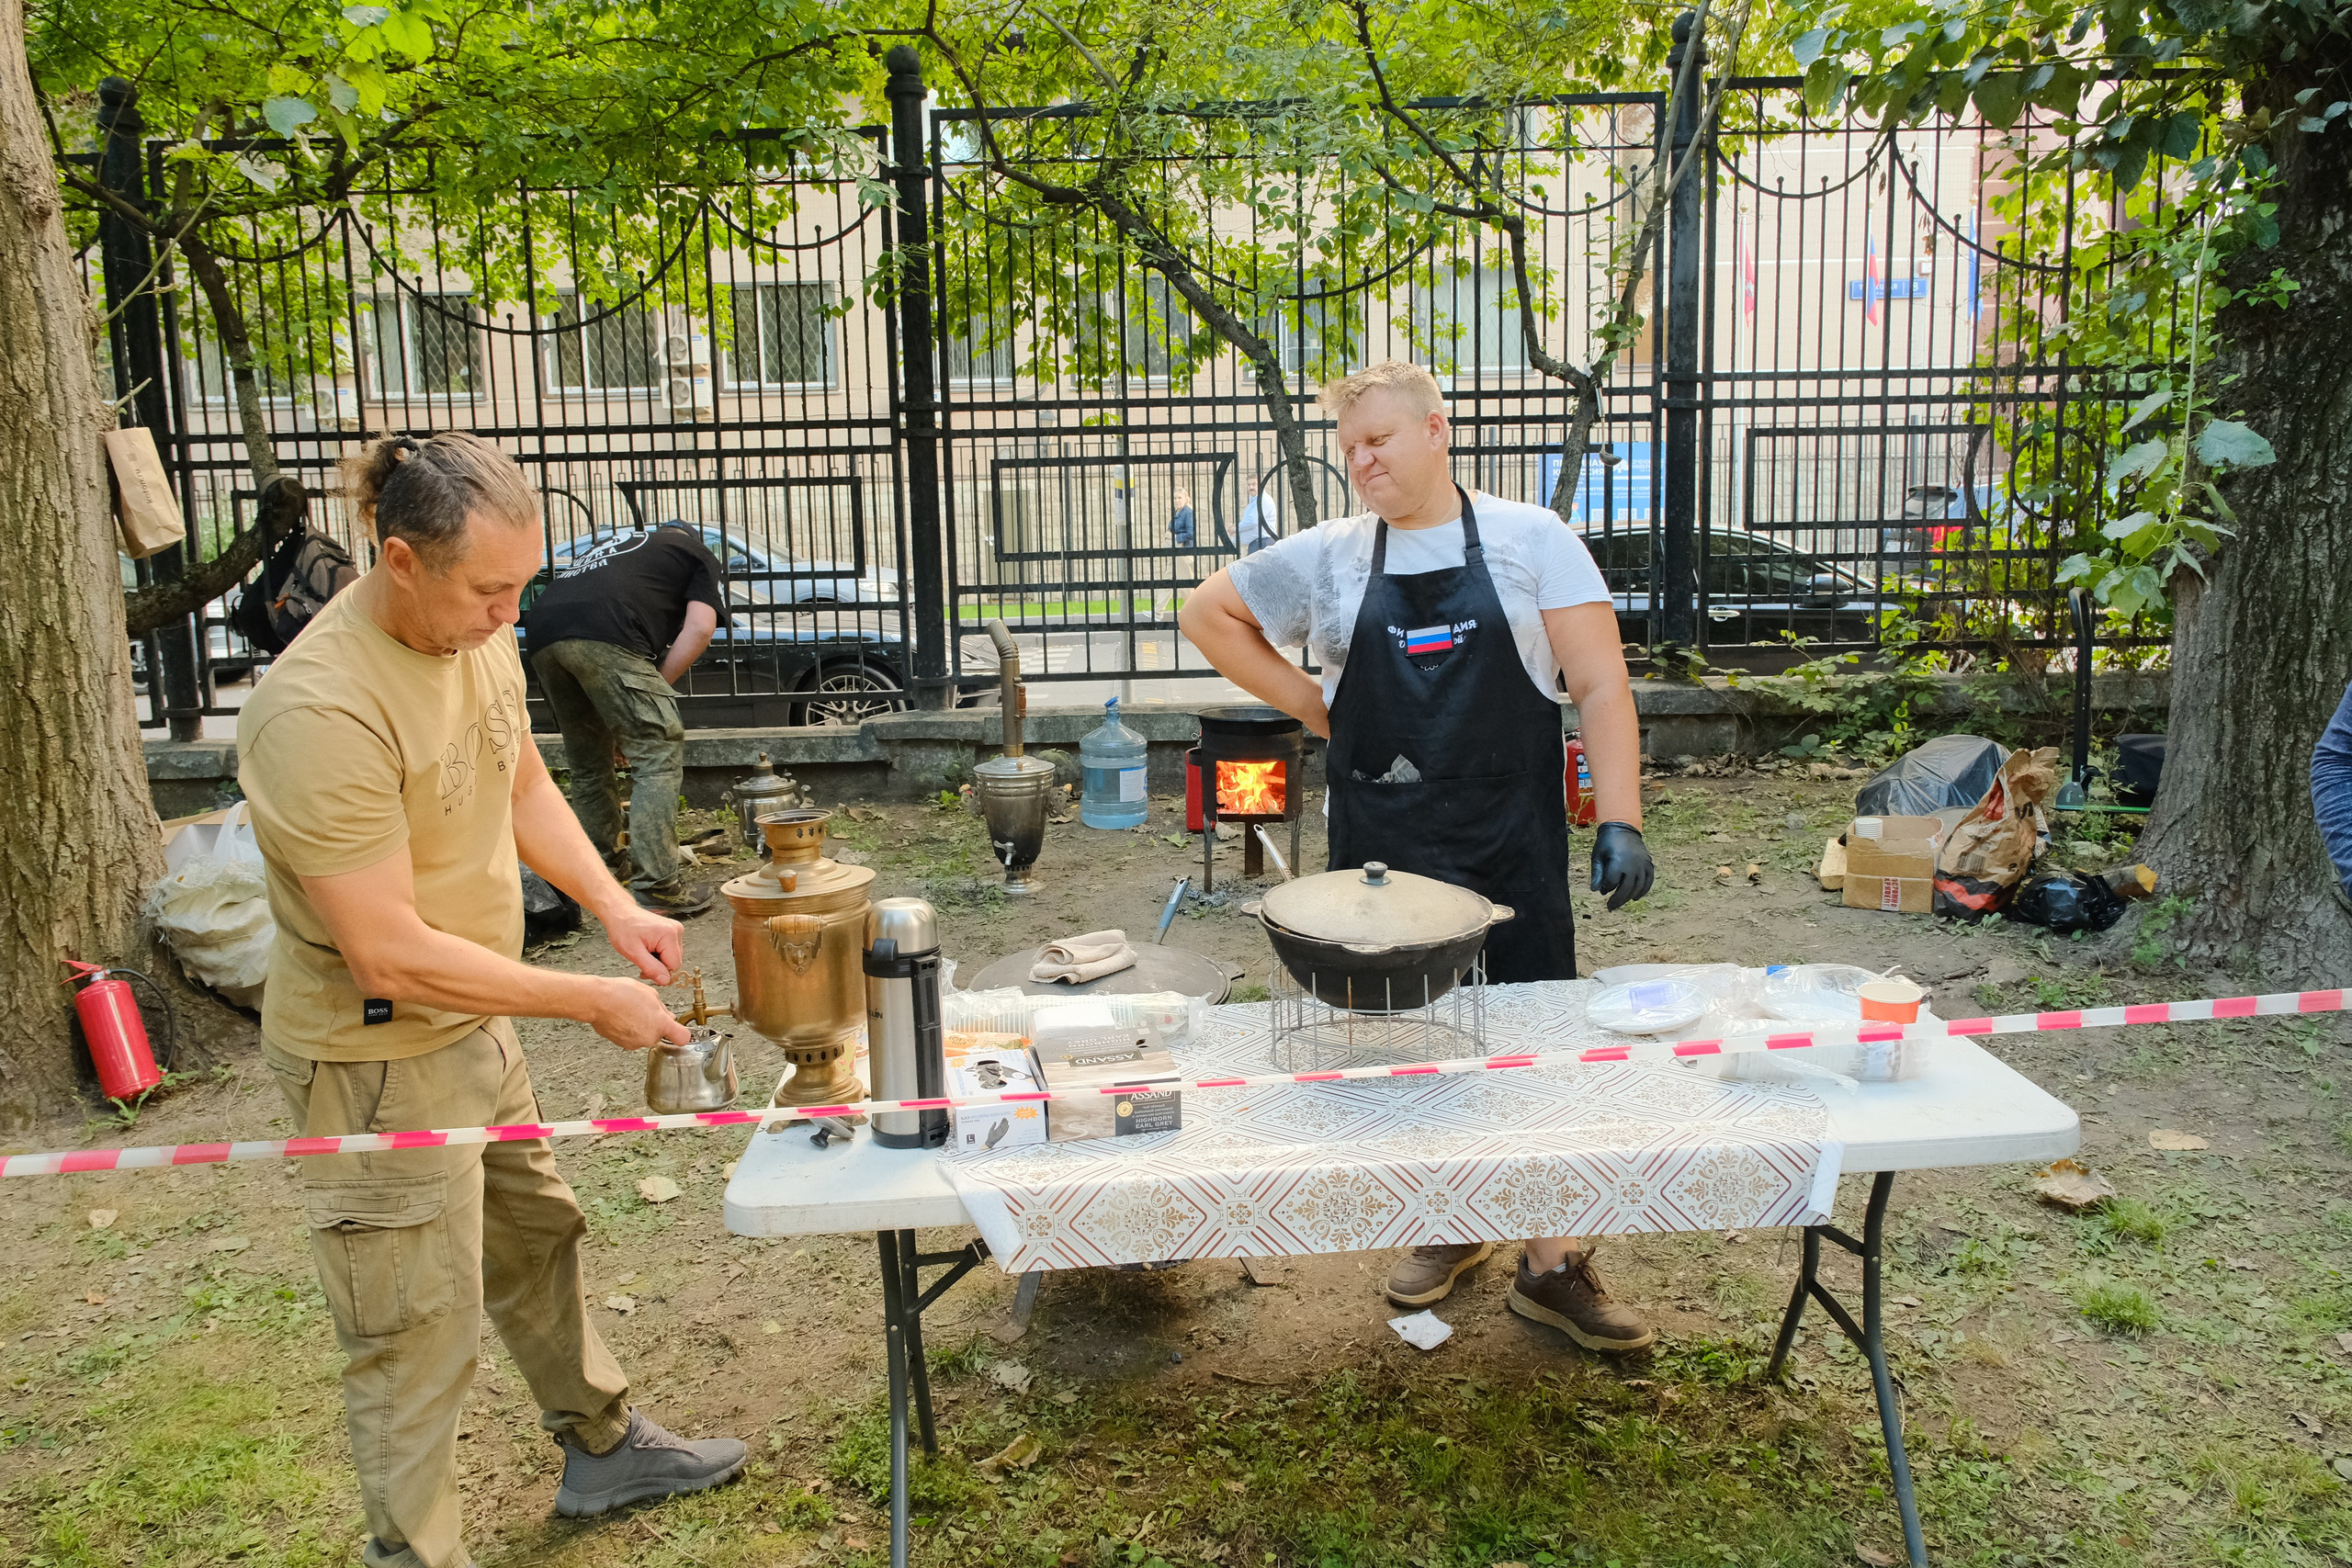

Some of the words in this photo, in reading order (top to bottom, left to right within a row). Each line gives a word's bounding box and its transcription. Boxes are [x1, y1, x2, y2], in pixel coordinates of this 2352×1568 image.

[135, 468, 153, 504] koton.ru
[440, 687, 517, 800] BOSS
[1069, 1038, 1131, 1047] HIGHBORN
[1075, 1053, 1135, 1064] ASSAND
[1130, 1090, 1171, 1100] ASSAND
[1136, 1114, 1173, 1123] HIGHBORN
